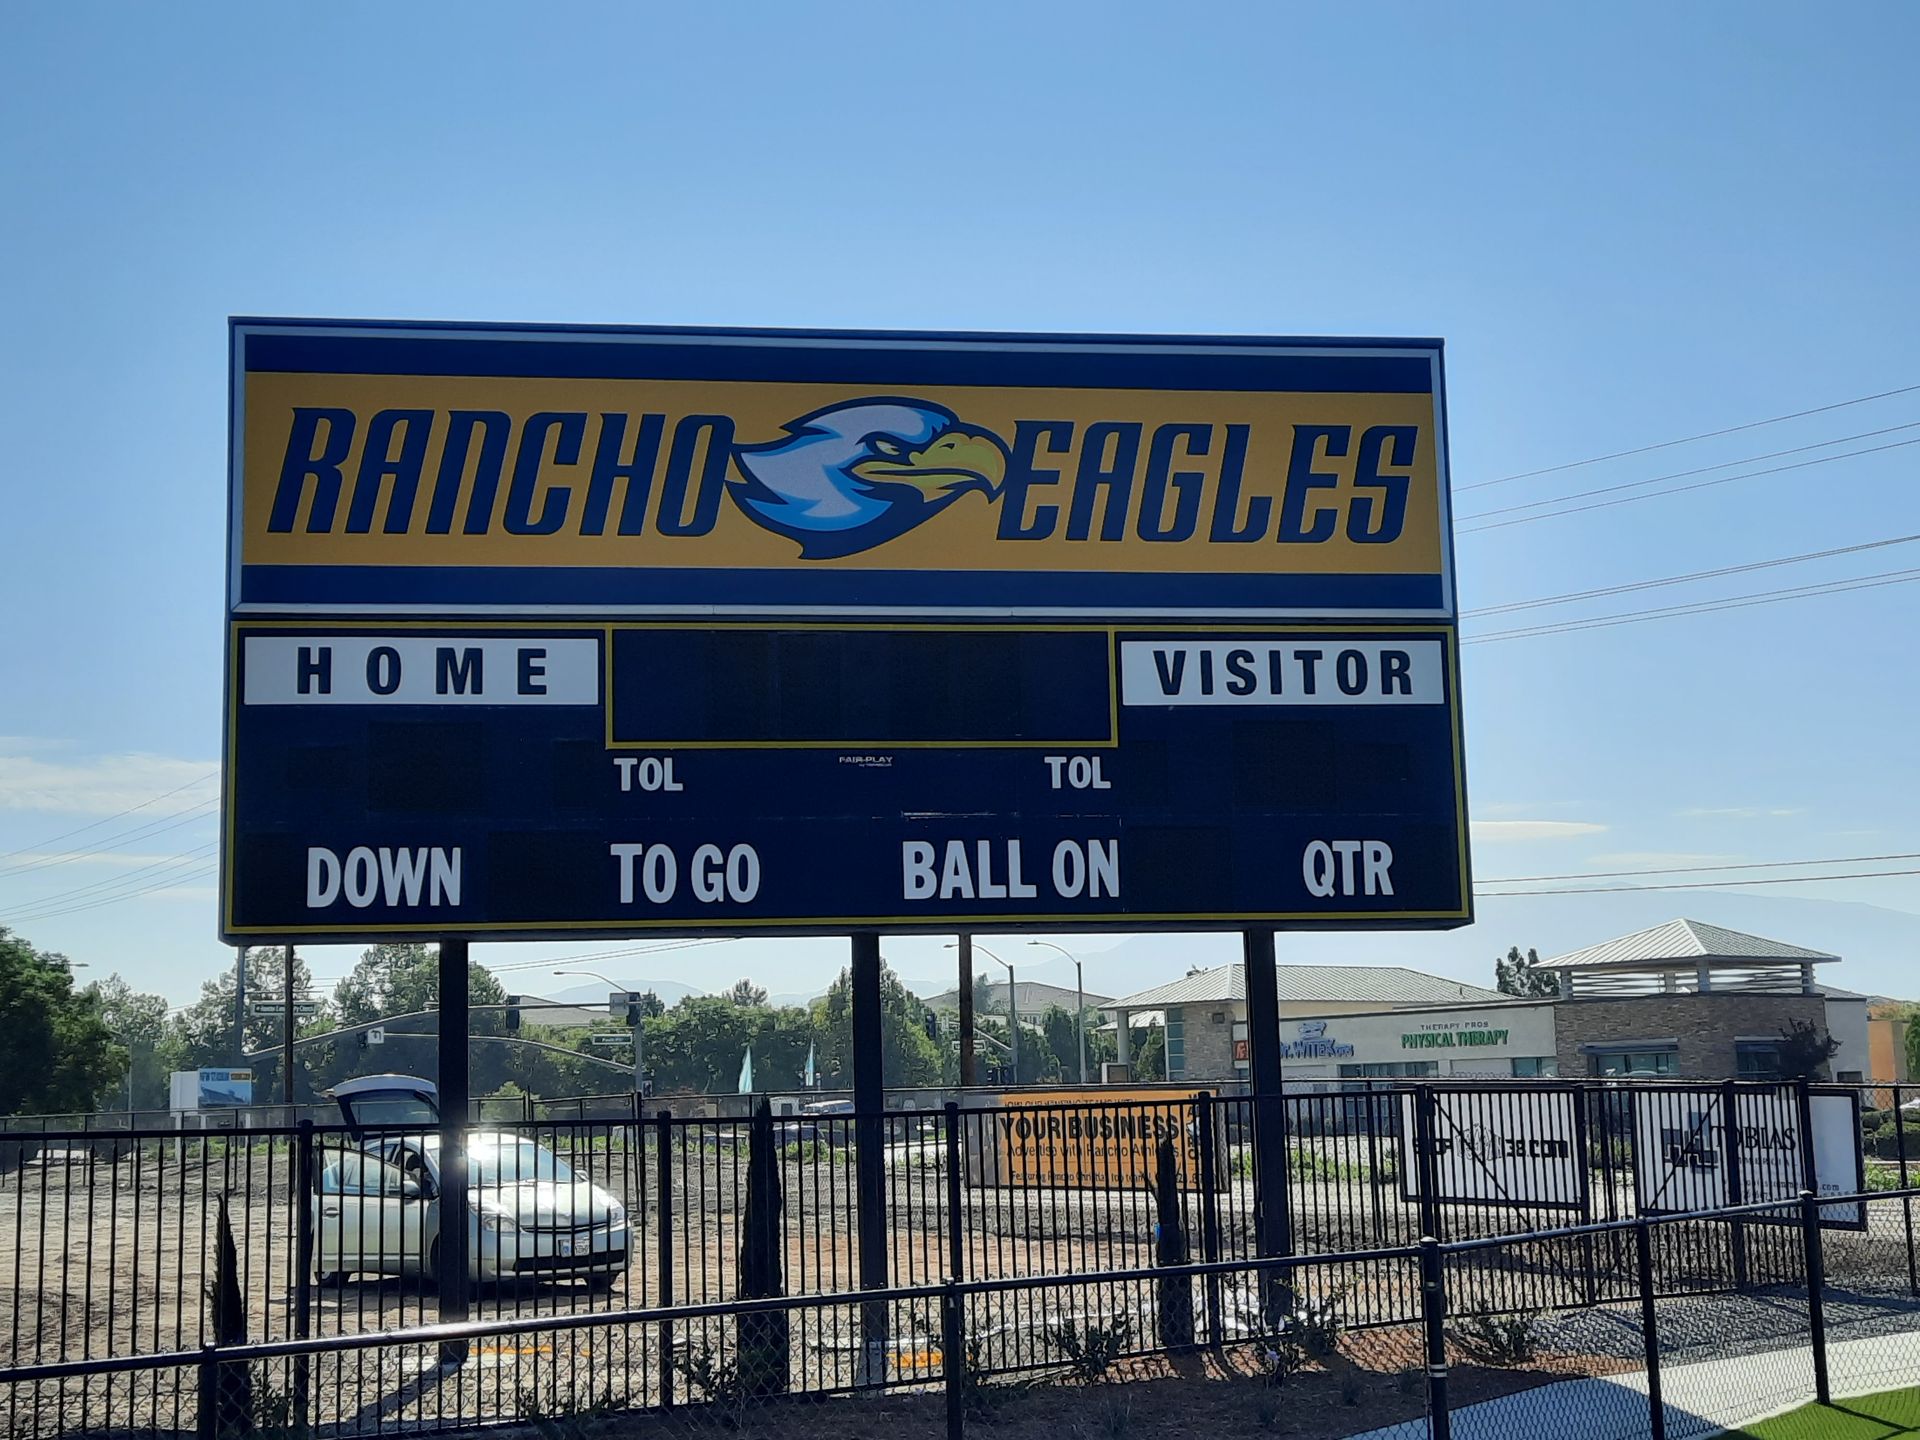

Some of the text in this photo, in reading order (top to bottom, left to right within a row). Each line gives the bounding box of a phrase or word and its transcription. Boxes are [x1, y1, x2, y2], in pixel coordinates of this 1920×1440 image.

[266, 407, 736, 537] RANCHO
[996, 420, 1418, 543] EAGLES
[296, 646, 548, 696] HOME
[1153, 649, 1413, 696] VISITOR
[613, 757, 683, 791] TOL
[1044, 756, 1112, 789] TOL
[307, 847, 461, 908] DOWN
[610, 843, 760, 904] TO GO
[902, 839, 1120, 900] BALL ON
[1303, 840, 1394, 897] QTR
[1402, 1029, 1509, 1049] PHYSICAL THERAPY
[999, 1115, 1179, 1140] YOUR BUSINESS
